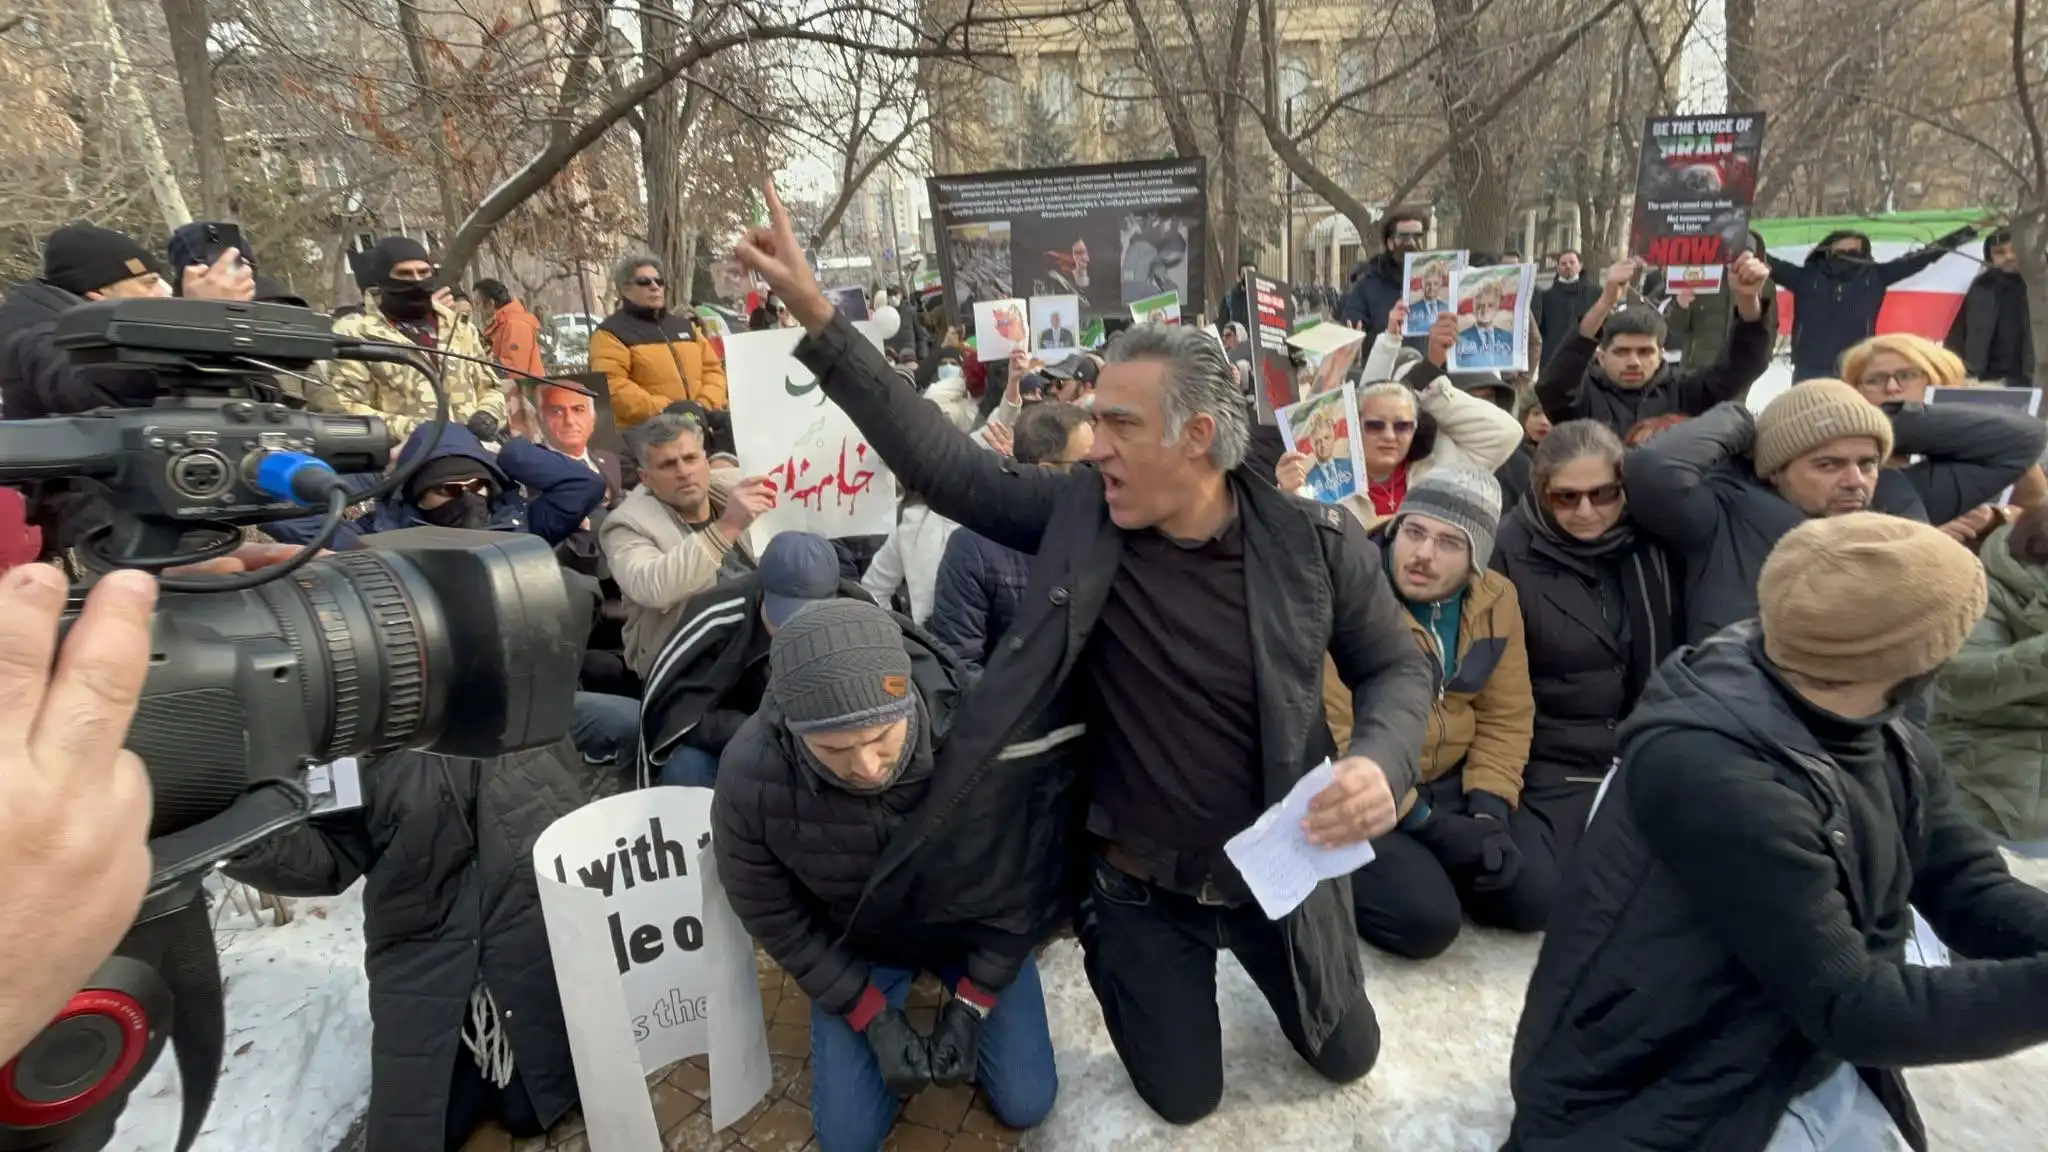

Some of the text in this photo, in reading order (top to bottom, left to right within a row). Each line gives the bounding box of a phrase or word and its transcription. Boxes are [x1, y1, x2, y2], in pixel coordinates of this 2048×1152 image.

[1653, 117, 1753, 136] BE THE VOICE OF
[1648, 235, 1722, 265] NOW
[576, 816, 688, 898] with
